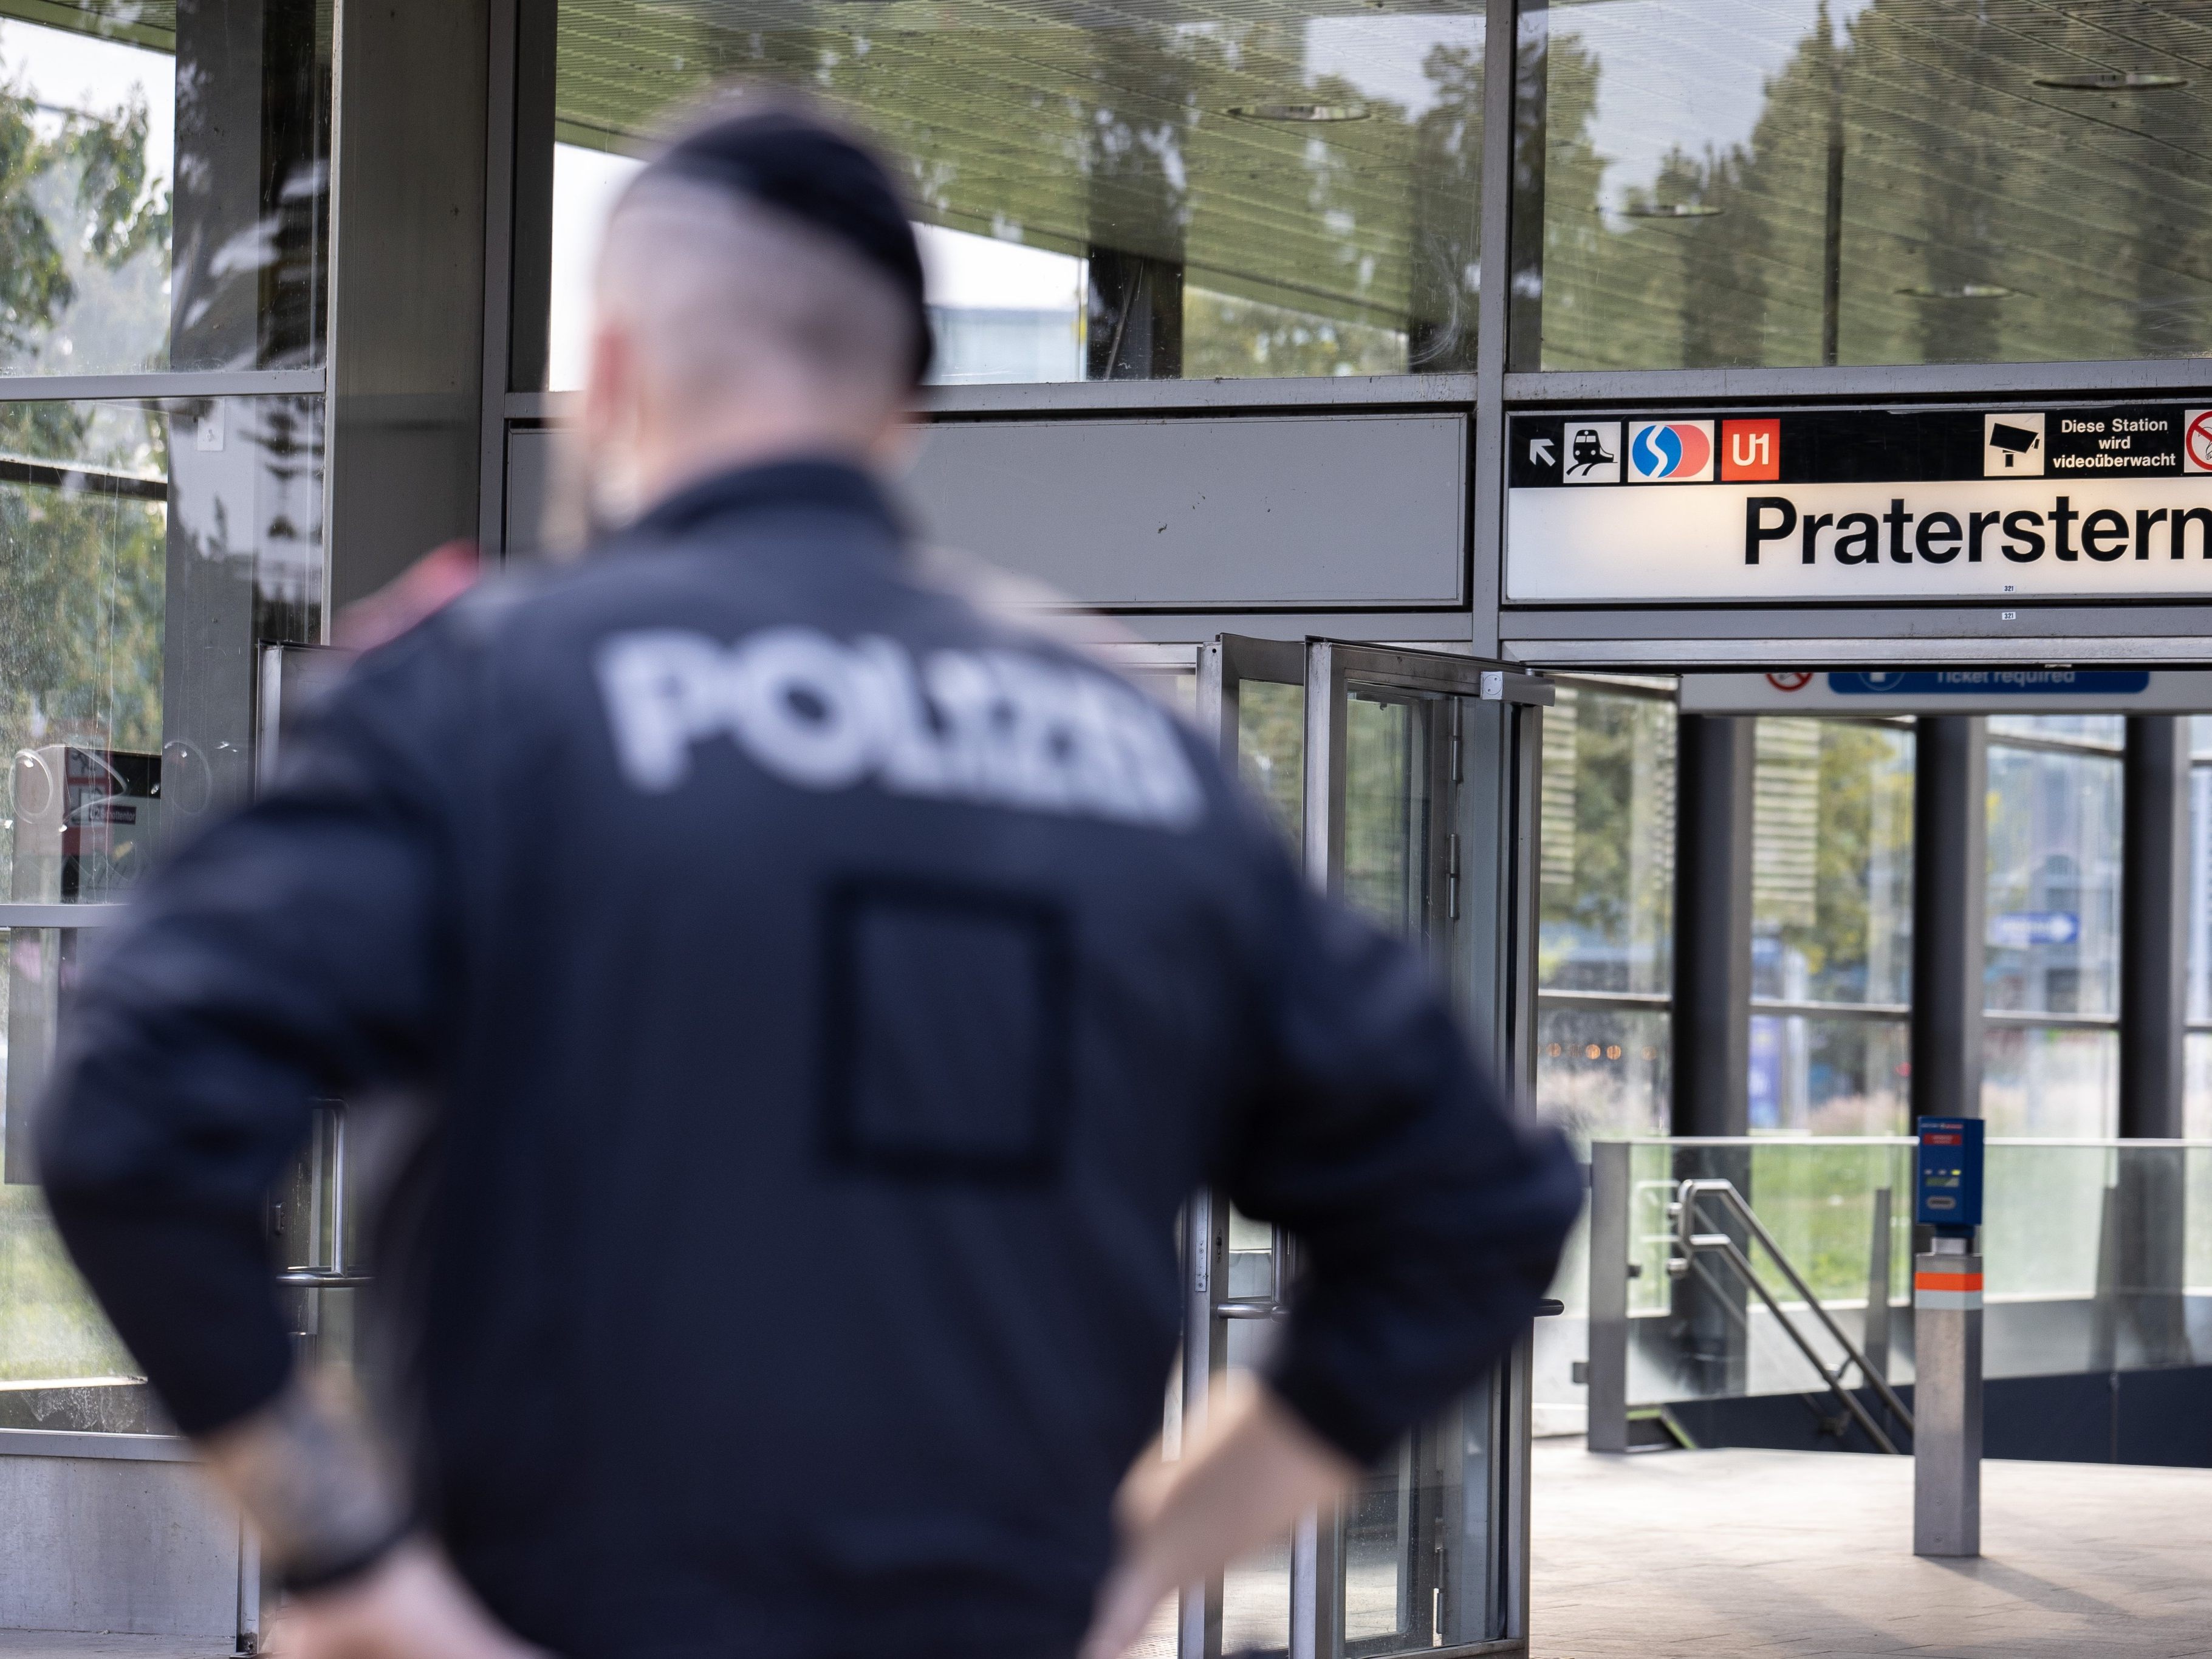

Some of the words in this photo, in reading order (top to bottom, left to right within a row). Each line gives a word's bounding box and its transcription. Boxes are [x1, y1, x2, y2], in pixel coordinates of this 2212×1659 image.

[2061, 419, 2105, 433] Diese
[2112, 418, 2168, 433] Station
[1733, 433, 1769, 467] U1
[2098, 436, 2131, 450] wird
[2053, 453, 2176, 468] videoüberwacht
[1745, 496, 2212, 566] Praterstern
